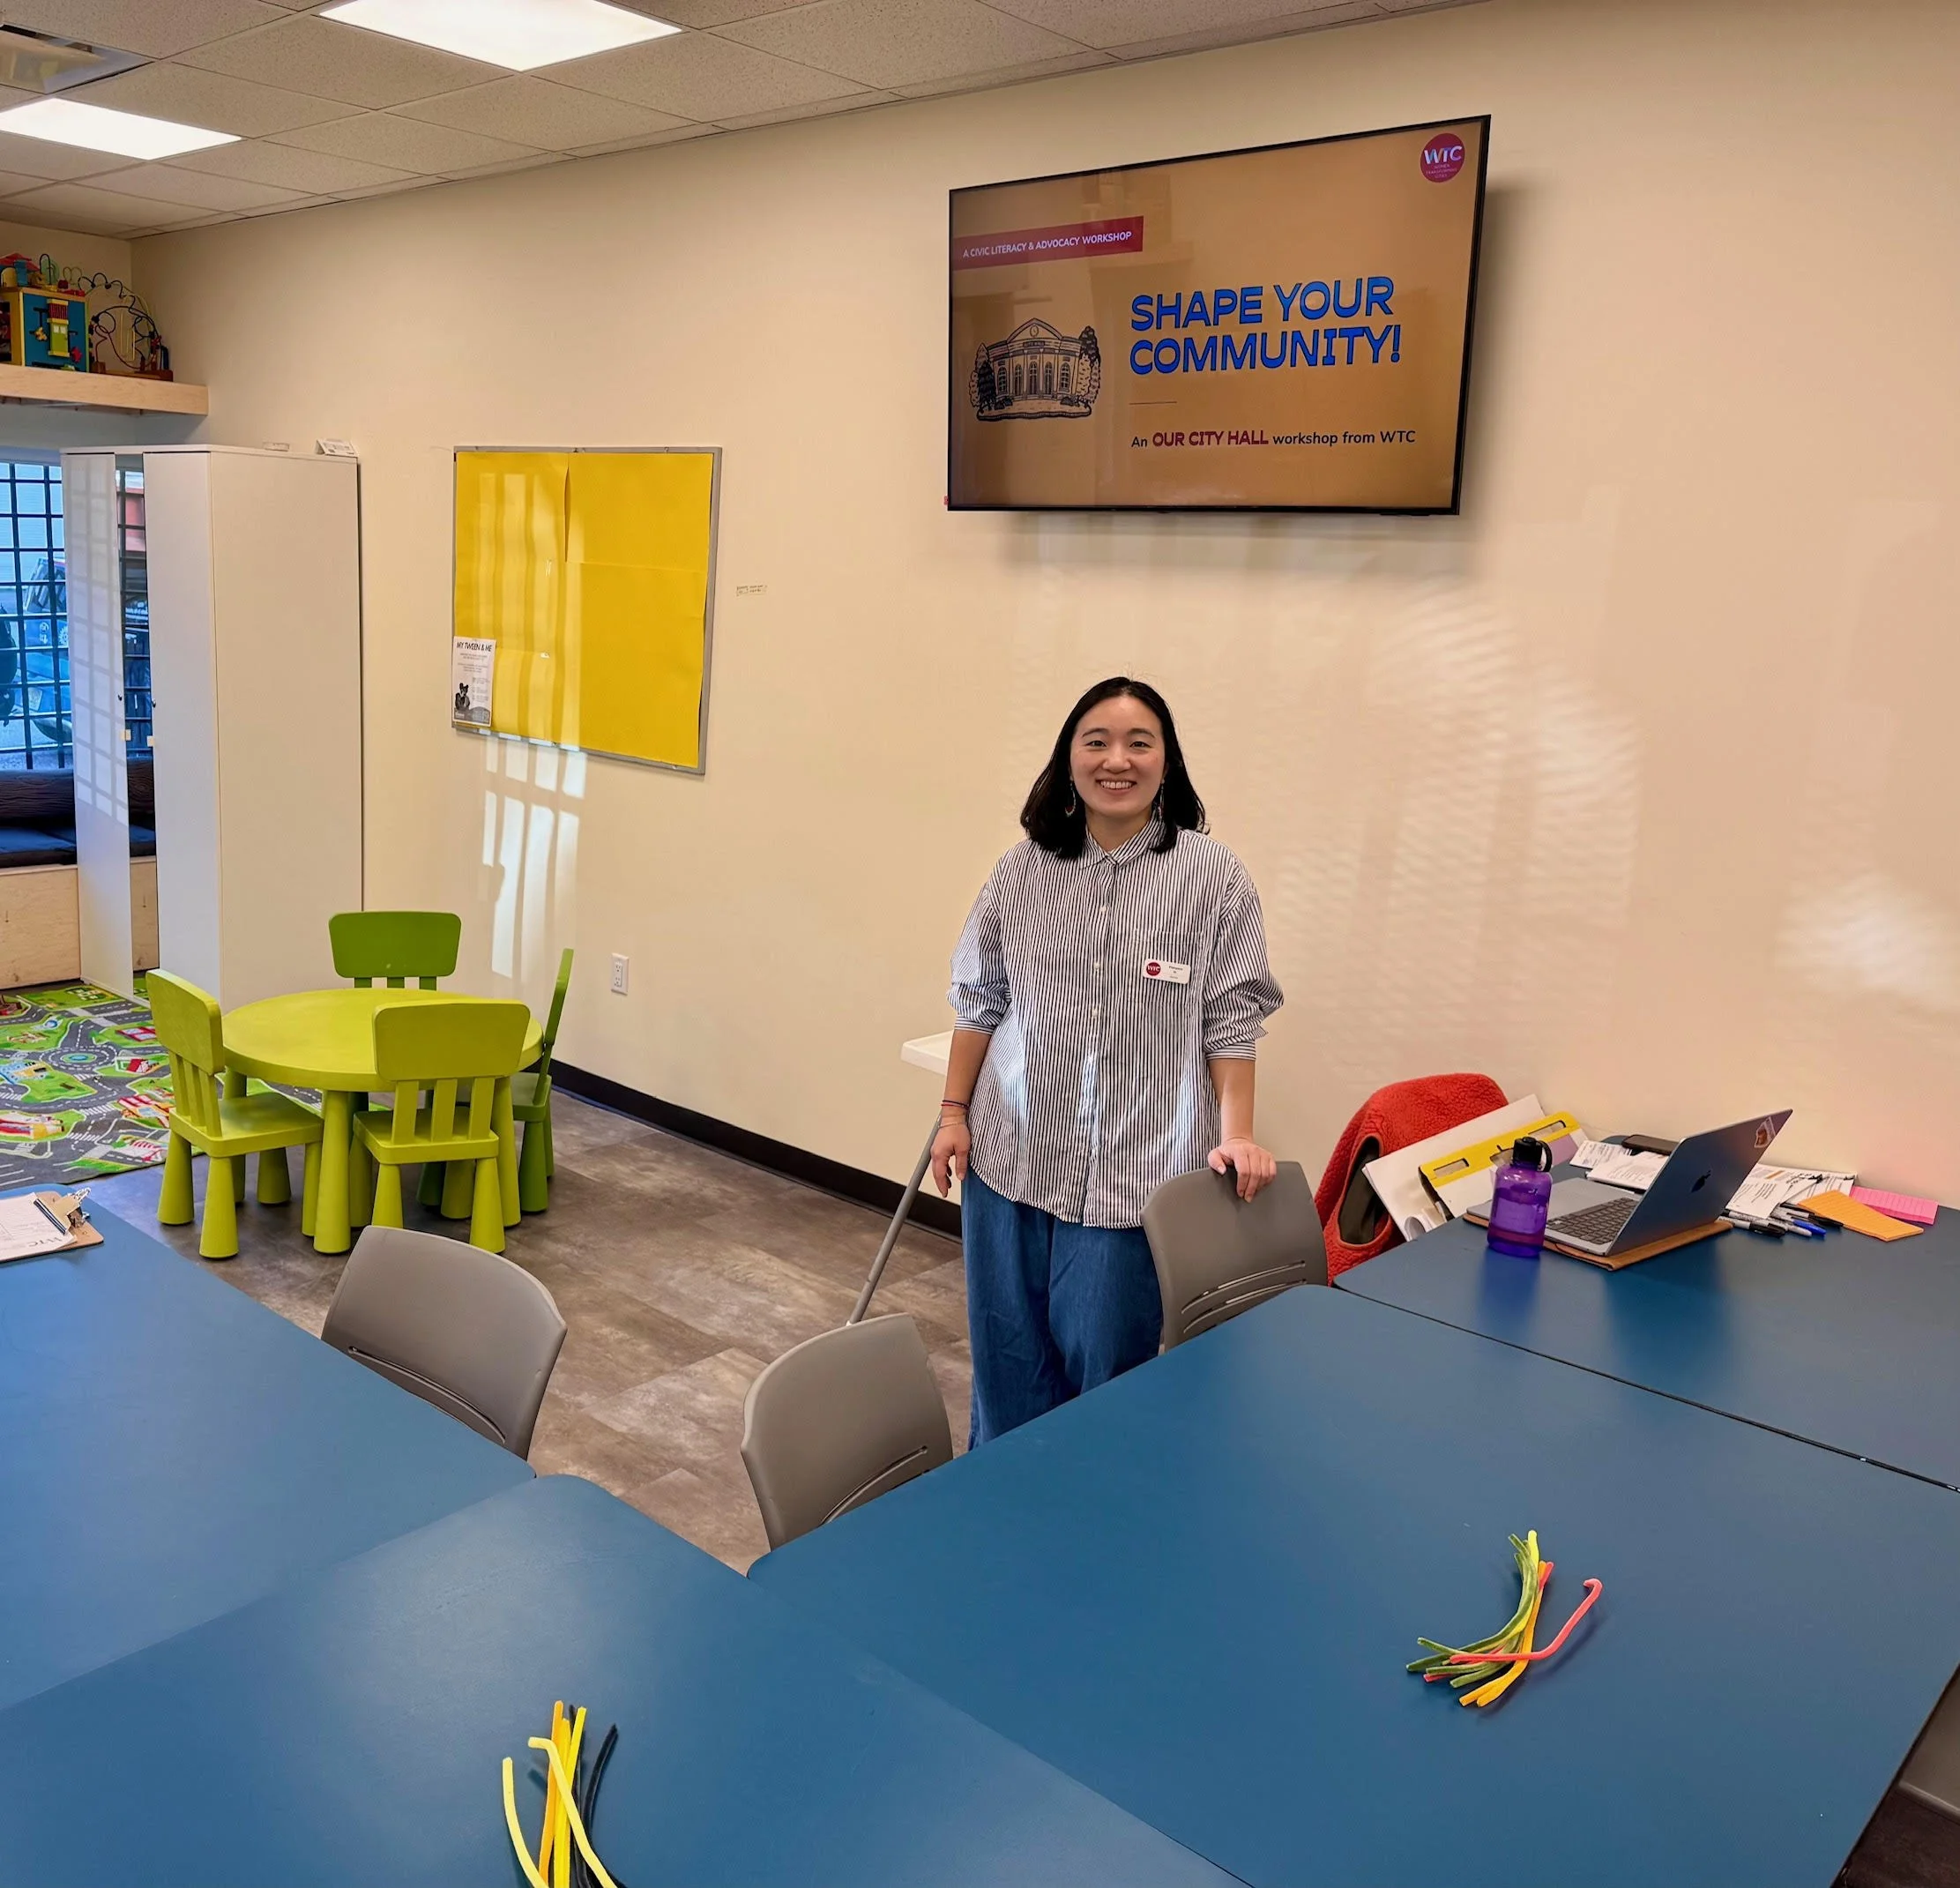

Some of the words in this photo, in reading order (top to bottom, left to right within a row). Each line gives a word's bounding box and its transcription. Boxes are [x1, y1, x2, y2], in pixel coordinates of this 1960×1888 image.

[1424, 146, 1463, 164] WTC
[963, 250, 970, 258] A
[970, 247, 989, 257] CIVIC
[991, 243, 1026, 255] LITERACY
[1028, 242, 1035, 250] &
[1035, 236, 1080, 250] ADVOCACY
[1082, 231, 1132, 244] WORKSHOP
[1130, 286, 1263, 332] SHAPE
[1273, 276, 1394, 322] YOUR
[1129, 325, 1401, 375] COMMUNITY!
[1131, 437, 1147, 447] An
[1152, 432, 1185, 447] OUR
[1189, 430, 1225, 446] CITY
[1227, 429, 1269, 445] HALL
[1272, 431, 1338, 447] workshop
[1342, 431, 1375, 444] from
[1380, 430, 1416, 444] WTC
[465, 642, 481, 651] TWEEN
